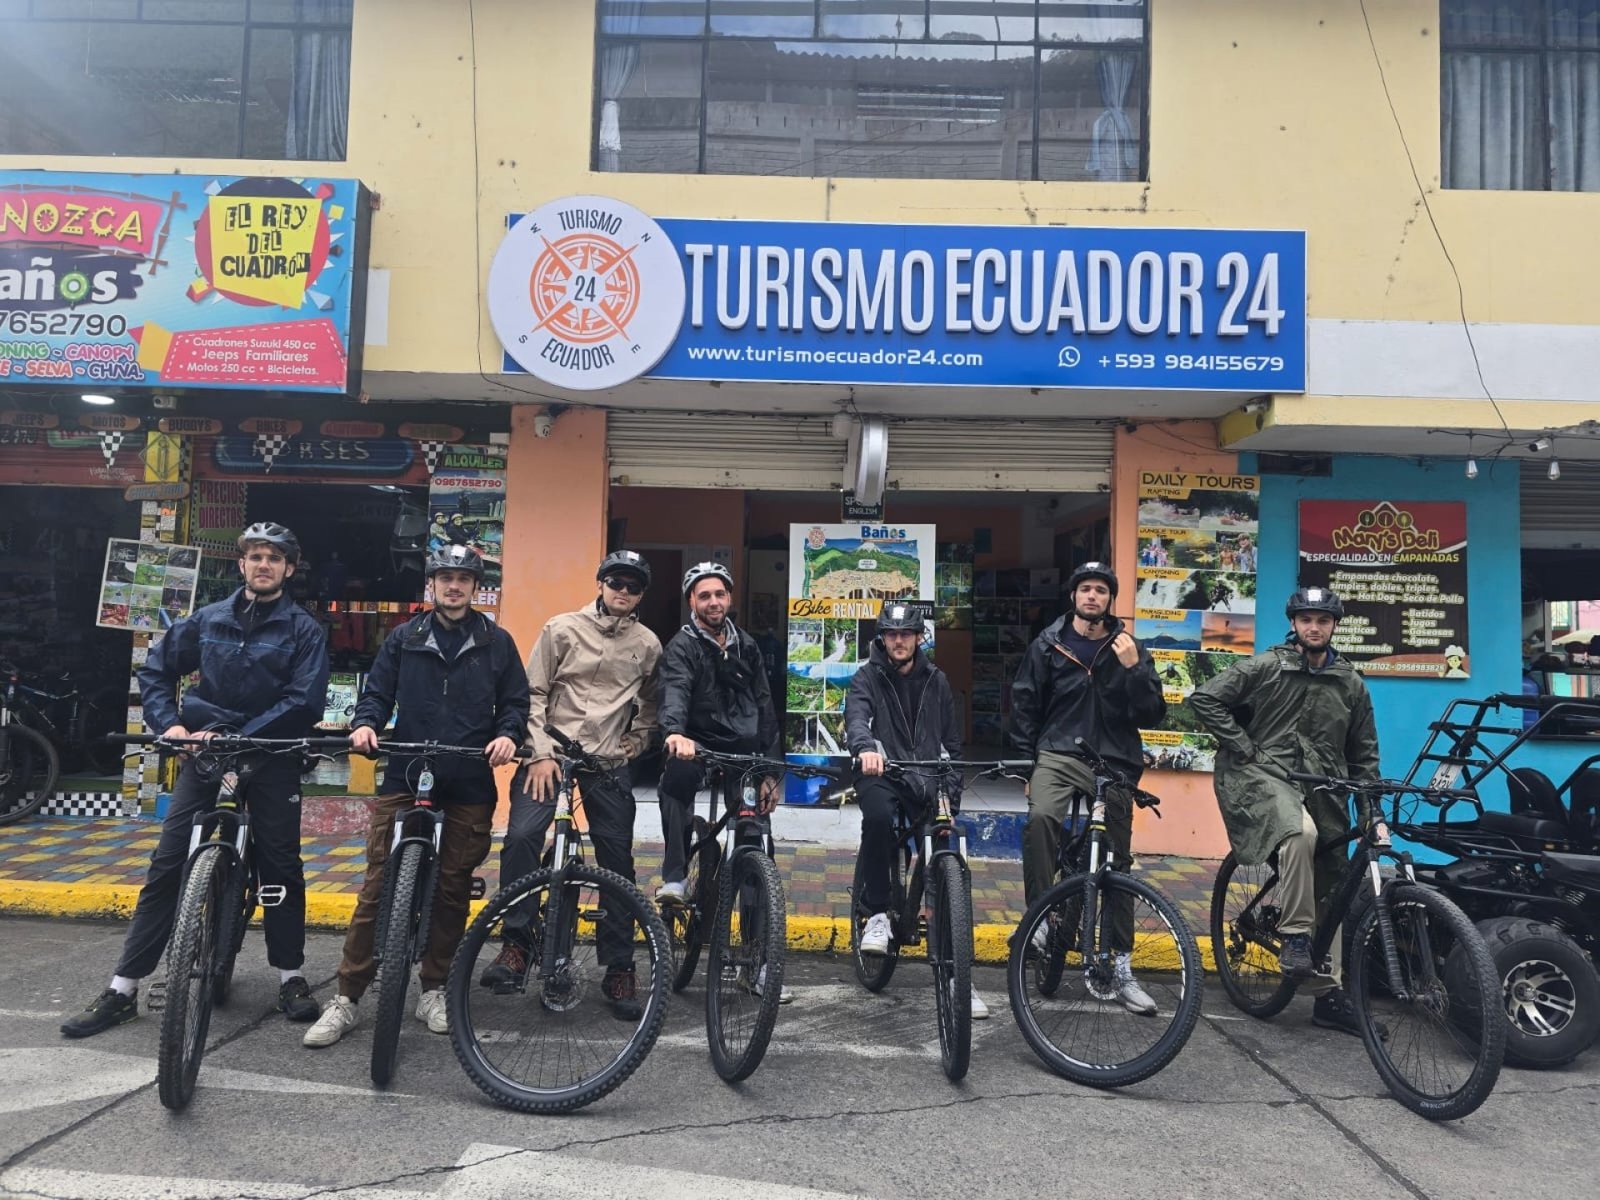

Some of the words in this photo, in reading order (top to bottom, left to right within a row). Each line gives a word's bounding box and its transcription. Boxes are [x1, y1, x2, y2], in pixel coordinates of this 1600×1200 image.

[0, 198, 142, 243] NOZCA
[225, 203, 251, 231] EL
[262, 203, 307, 230] REY
[557, 209, 622, 236] TURISMO
[530, 223, 541, 234] W
[246, 229, 282, 255] DEL
[641, 233, 652, 243] N
[574, 275, 596, 302] 24
[685, 243, 934, 334] TURISMO
[945, 248, 1204, 336] ECUADOR
[1216, 251, 1286, 337] 24
[193, 337, 248, 348] Cuadrones
[250, 338, 281, 348] Suzuki
[283, 340, 301, 349] 450
[303, 341, 317, 350] cc
[519, 334, 528, 344] S
[64, 343, 135, 361] CANOPY
[202, 349, 239, 362] Jeeps
[246, 349, 309, 361] Familiares
[541, 338, 615, 371] ECUADOR
[632, 344, 641, 353] E
[688, 346, 983, 367] www.turismoecuador24.com
[25, 360, 73, 377] SELVA
[187, 362, 218, 372] Motos
[221, 364, 239, 373] 250
[242, 365, 255, 373] cc
[1165, 353, 1284, 371] 984155679
[444, 454, 504, 469] ALQUILER
[1143, 472, 1187, 486] DAILY
[1196, 475, 1255, 489] TOURS
[200, 481, 244, 504] PRECIOS
[1147, 488, 1180, 496] RAFTING
[199, 506, 243, 528] DIRECTOS
[848, 507, 878, 515] ENGLISH
[861, 525, 906, 539] Baños
[1332, 526, 1397, 552] Mary's
[1400, 529, 1439, 549] Deli
[1306, 553, 1375, 562] ESPECIALIDAD
[1377, 554, 1391, 562] EN
[1392, 553, 1459, 563] EMPANADAS
[1335, 571, 1389, 582] Empanadas
[1358, 592, 1376, 601] Hot
[1377, 592, 1396, 604] Dog
[791, 598, 831, 617] Bike
[834, 602, 876, 619] RENTAL
